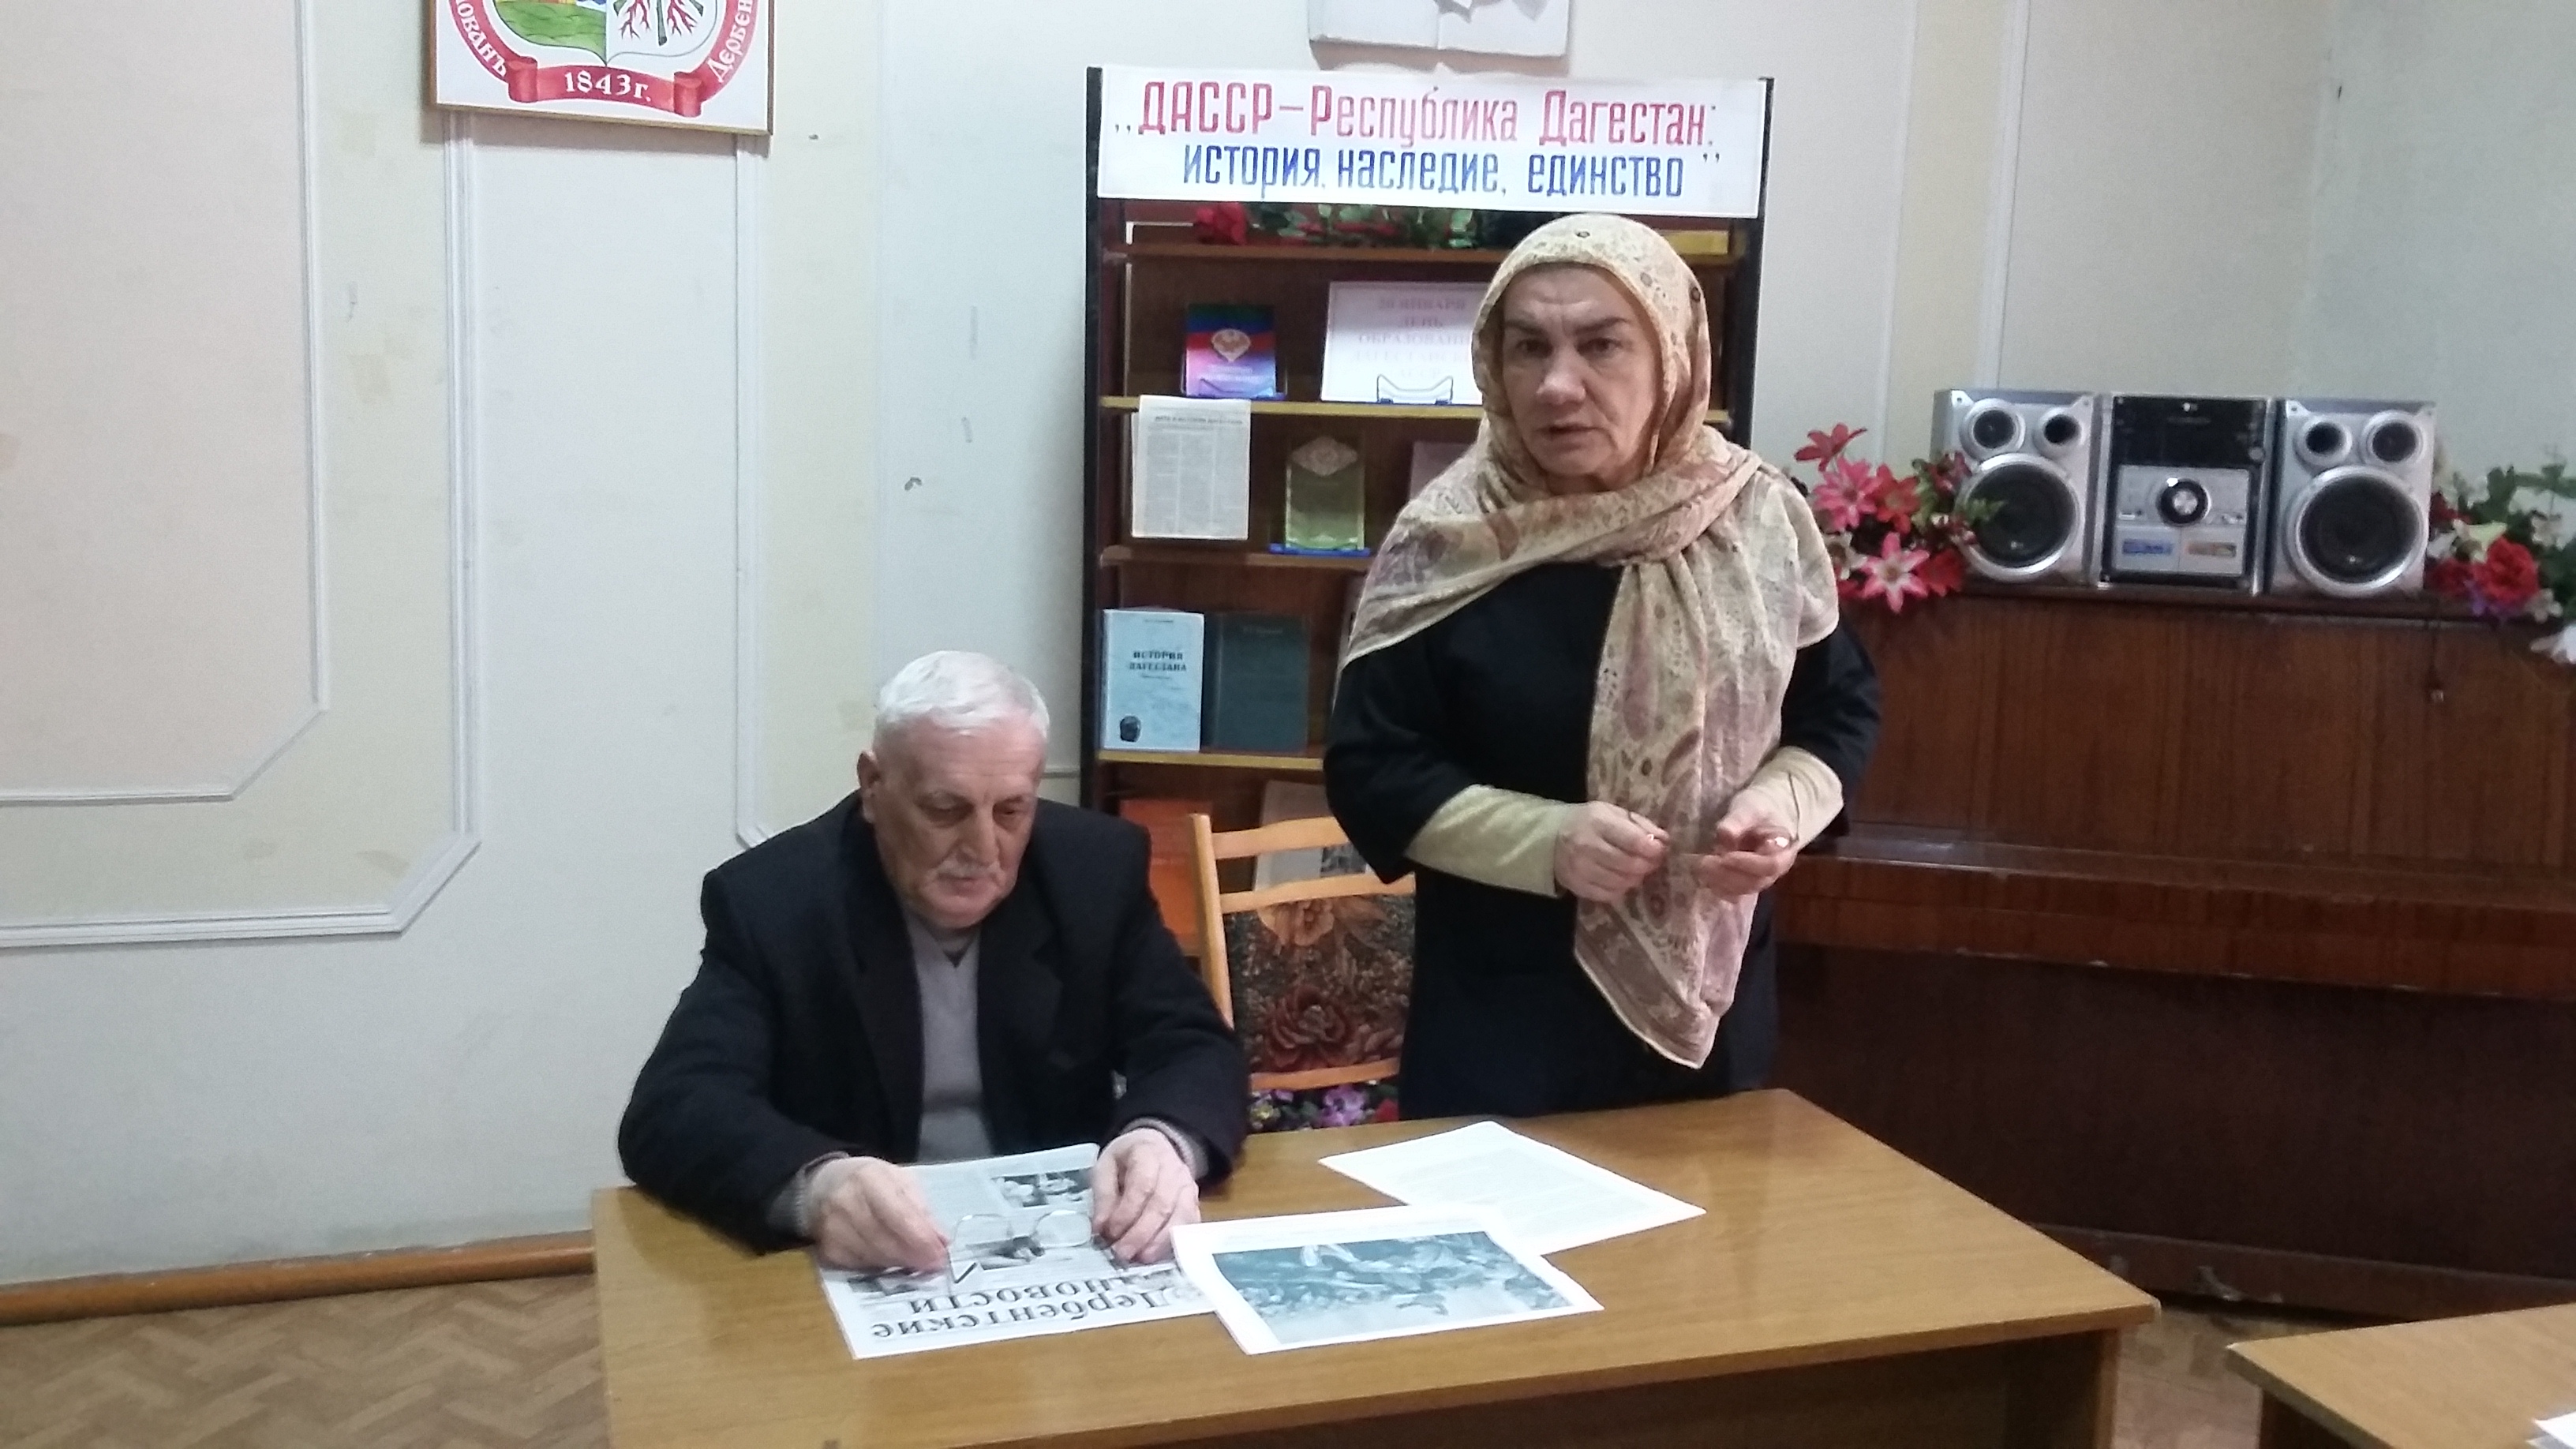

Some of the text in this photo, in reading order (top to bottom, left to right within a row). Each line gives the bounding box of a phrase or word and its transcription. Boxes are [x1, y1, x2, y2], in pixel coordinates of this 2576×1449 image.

[455, 0, 507, 77] ованъ
[1338, 148, 1507, 197] наследие,
[871, 1286, 1174, 1339] Дербентские
